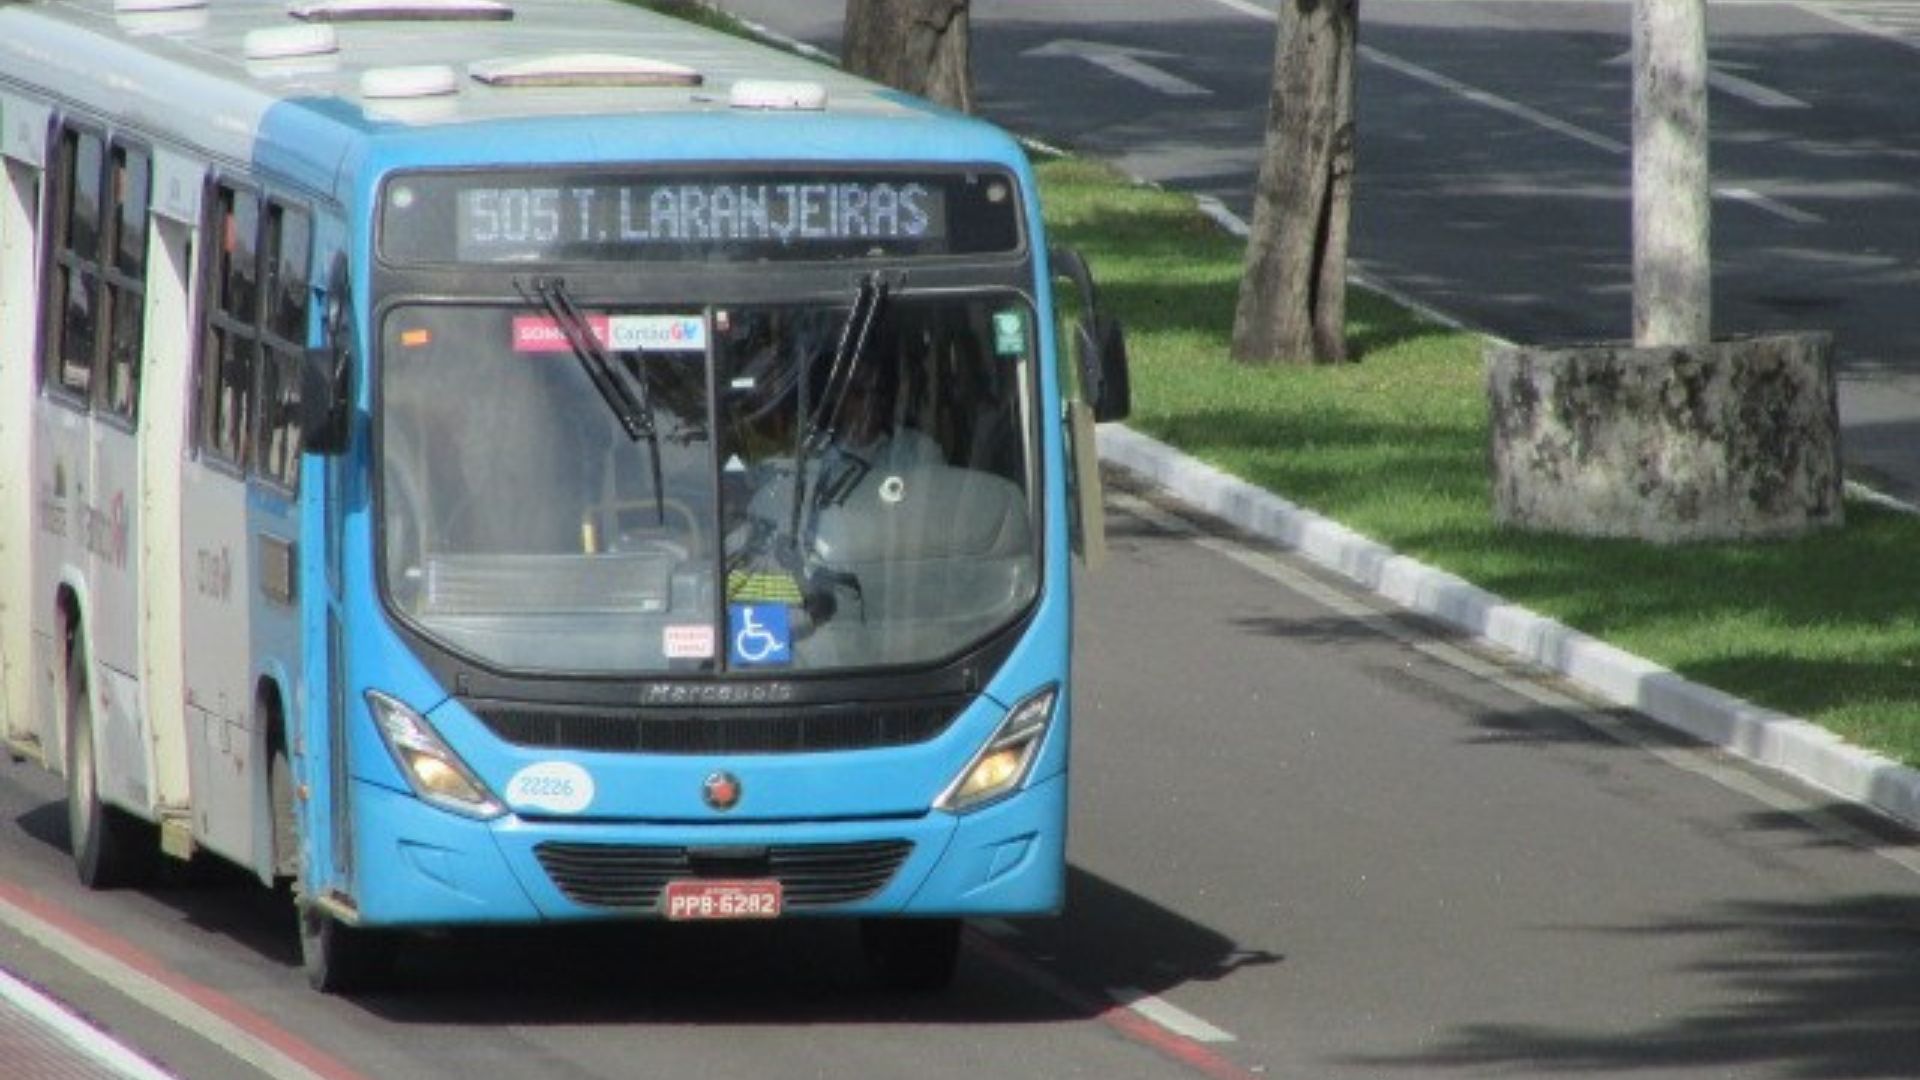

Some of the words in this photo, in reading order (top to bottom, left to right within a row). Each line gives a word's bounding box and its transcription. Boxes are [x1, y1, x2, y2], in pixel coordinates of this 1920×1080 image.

[470, 188, 560, 242] 505
[571, 187, 608, 242] T.
[620, 183, 930, 245] LARANJEIRAS
